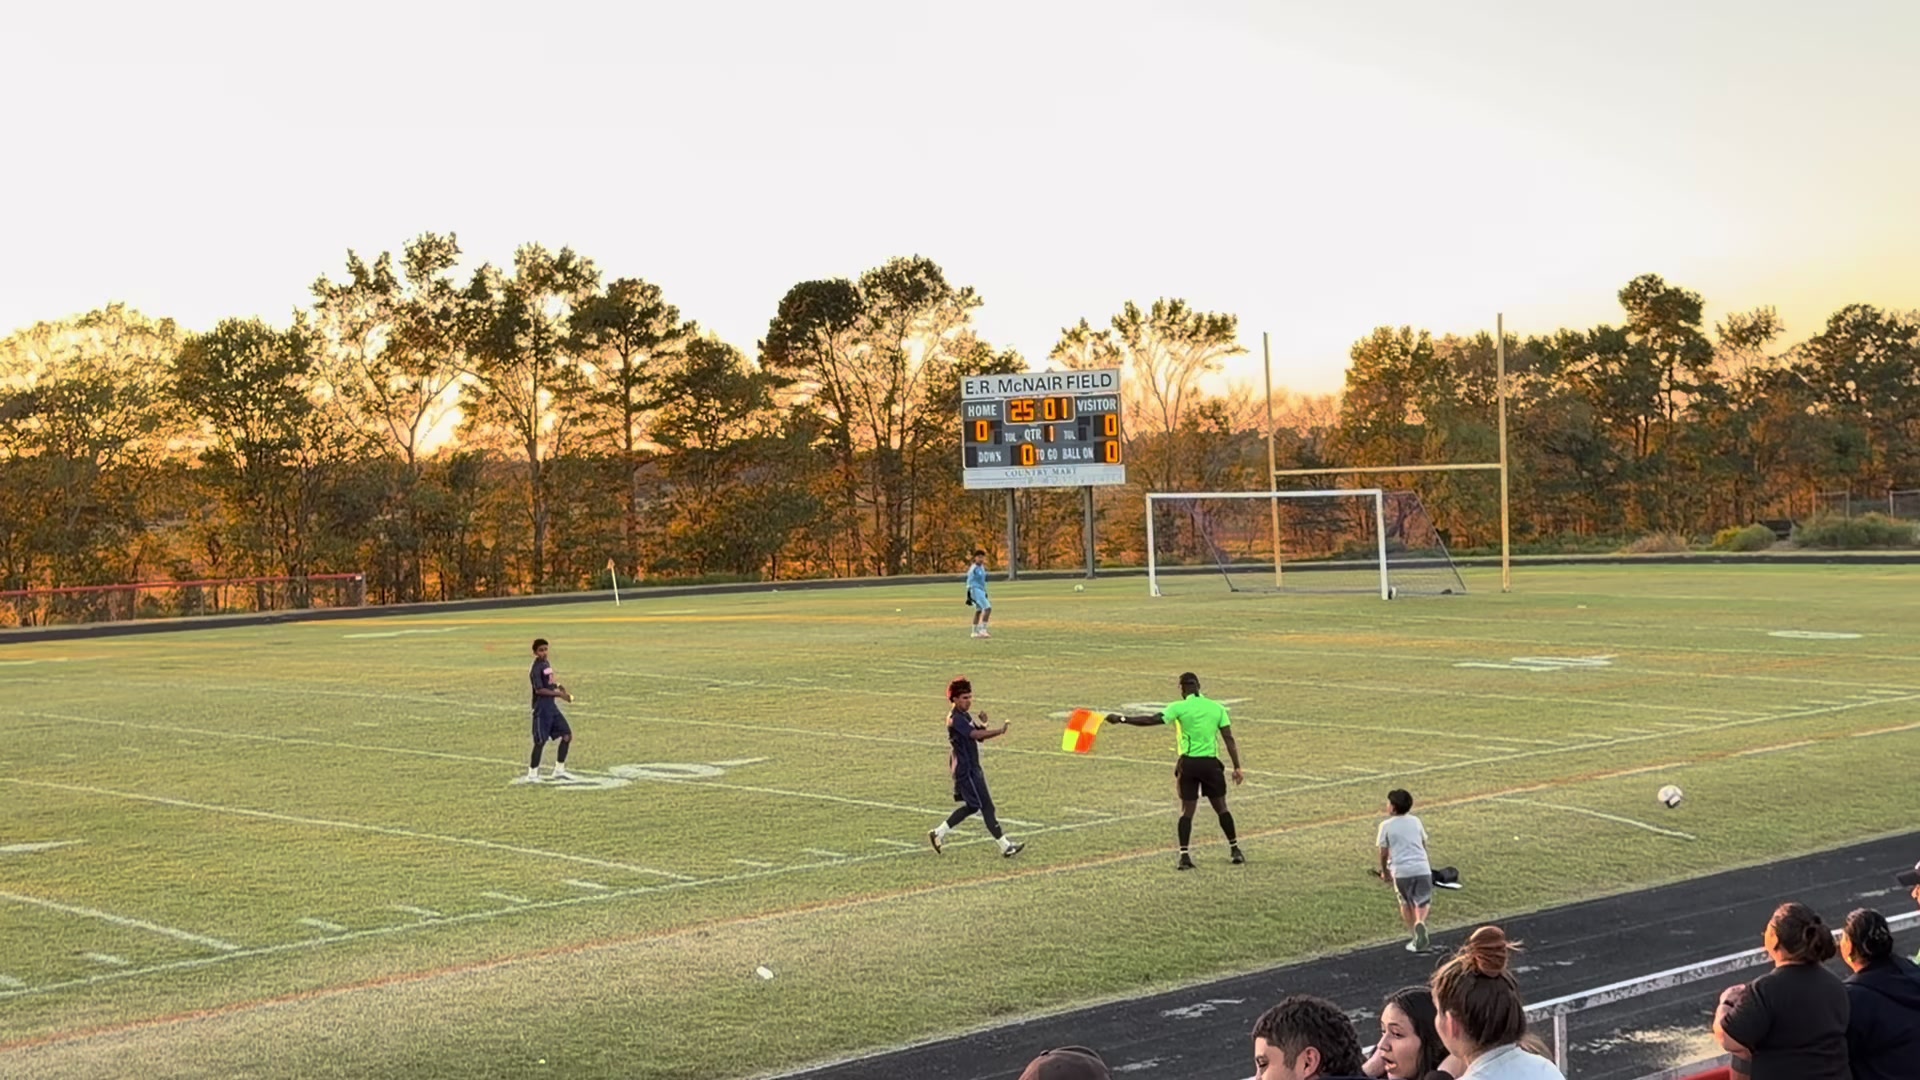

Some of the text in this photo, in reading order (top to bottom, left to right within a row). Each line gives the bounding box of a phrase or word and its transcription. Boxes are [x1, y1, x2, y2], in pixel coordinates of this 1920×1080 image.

[966, 373, 1112, 395] E.R. McNAIR FIELD
[968, 404, 997, 417] HOME
[1076, 398, 1117, 412] VISITOR
[976, 420, 988, 442] 0
[1105, 414, 1118, 437] 0
[1024, 428, 1042, 441] QTR
[978, 451, 1002, 463] DOWN
[1021, 443, 1034, 466] 0
[1035, 447, 1058, 461] TO GO
[1062, 446, 1094, 460] BALL ON
[1105, 440, 1118, 463] 0
